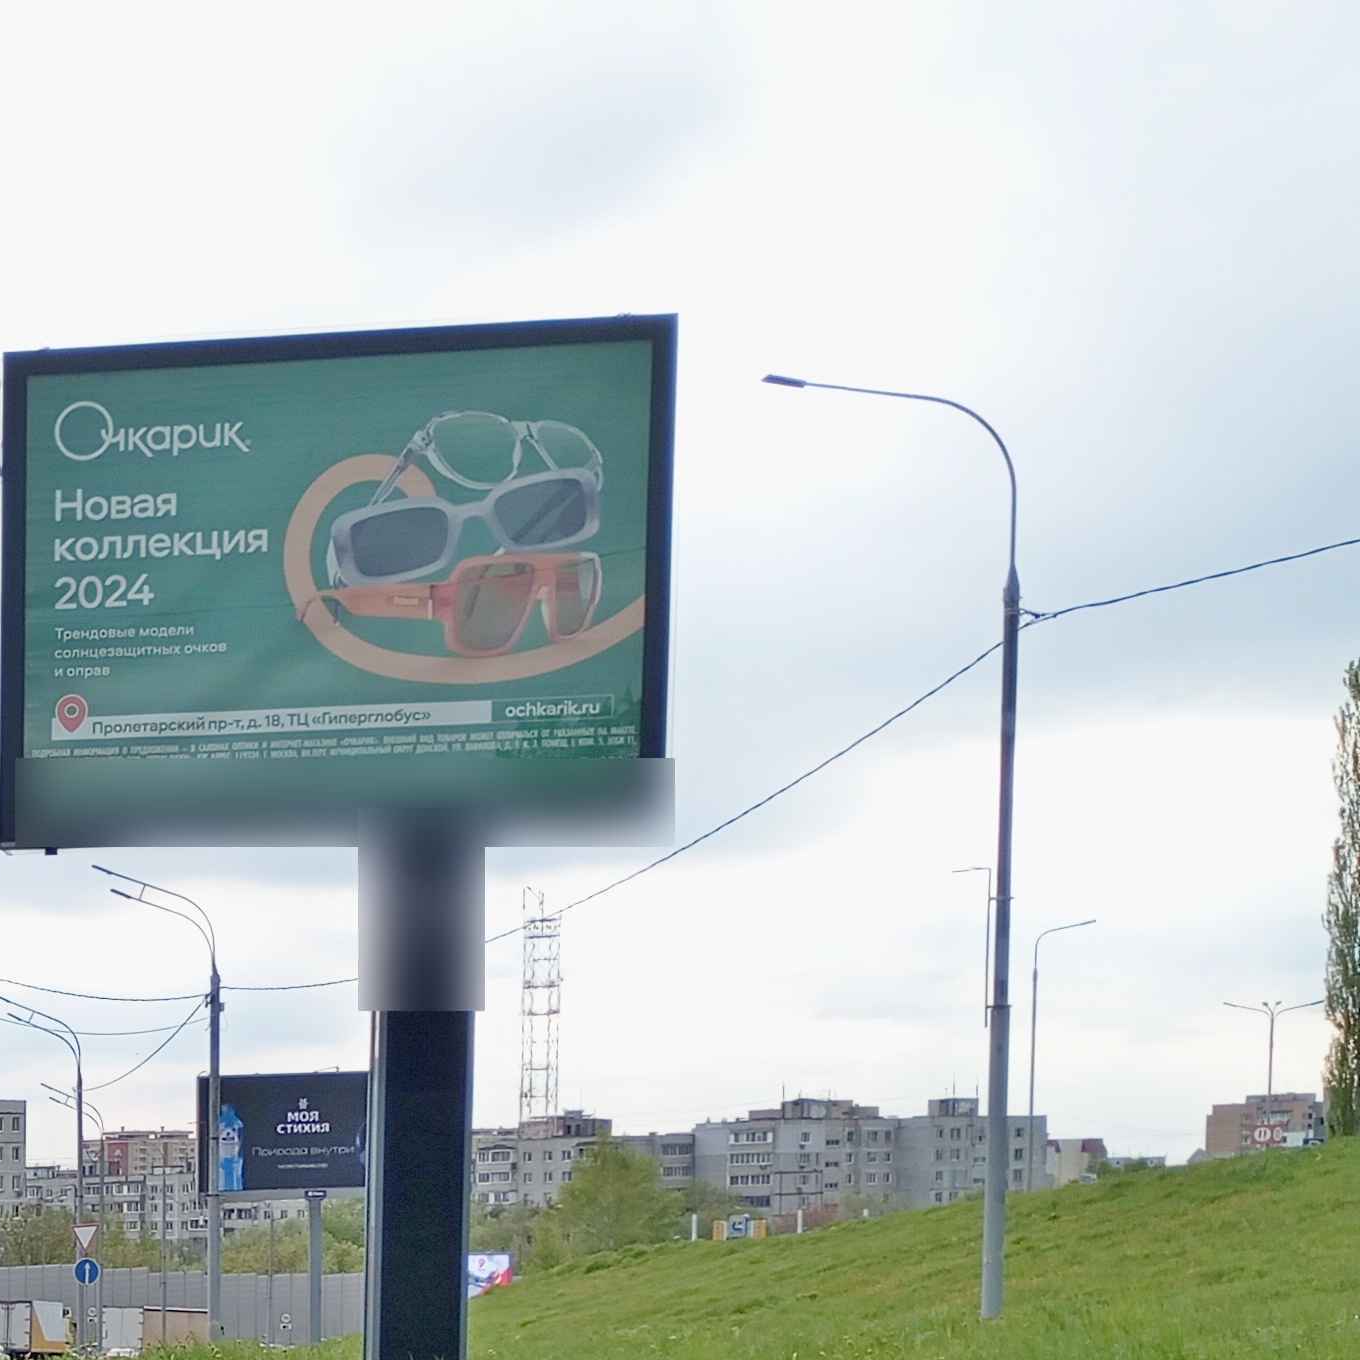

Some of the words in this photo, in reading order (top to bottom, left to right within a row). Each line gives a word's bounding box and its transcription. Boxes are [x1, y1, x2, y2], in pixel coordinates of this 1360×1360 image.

[54, 400, 250, 461] Очкарик
[54, 488, 178, 522] Новая
[53, 528, 269, 562] коллекция
[54, 573, 155, 610] 2024
[54, 626, 136, 642] Трендовые
[138, 625, 195, 639] модели
[54, 645, 180, 659] солнцезащитных
[183, 641, 228, 655] очков
[54, 667, 64, 677] и
[66, 665, 111, 679] оправ
[504, 699, 602, 718] ochkarik.ru
[91, 716, 206, 736] Пролетарский
[265, 713, 285, 729] 18,
[287, 713, 311, 728] ТЦ
[311, 708, 432, 726] «Гиперглобус»
[287, 1110, 320, 1122] МОЯ
[276, 1122, 330, 1134] СТИХИЯ
